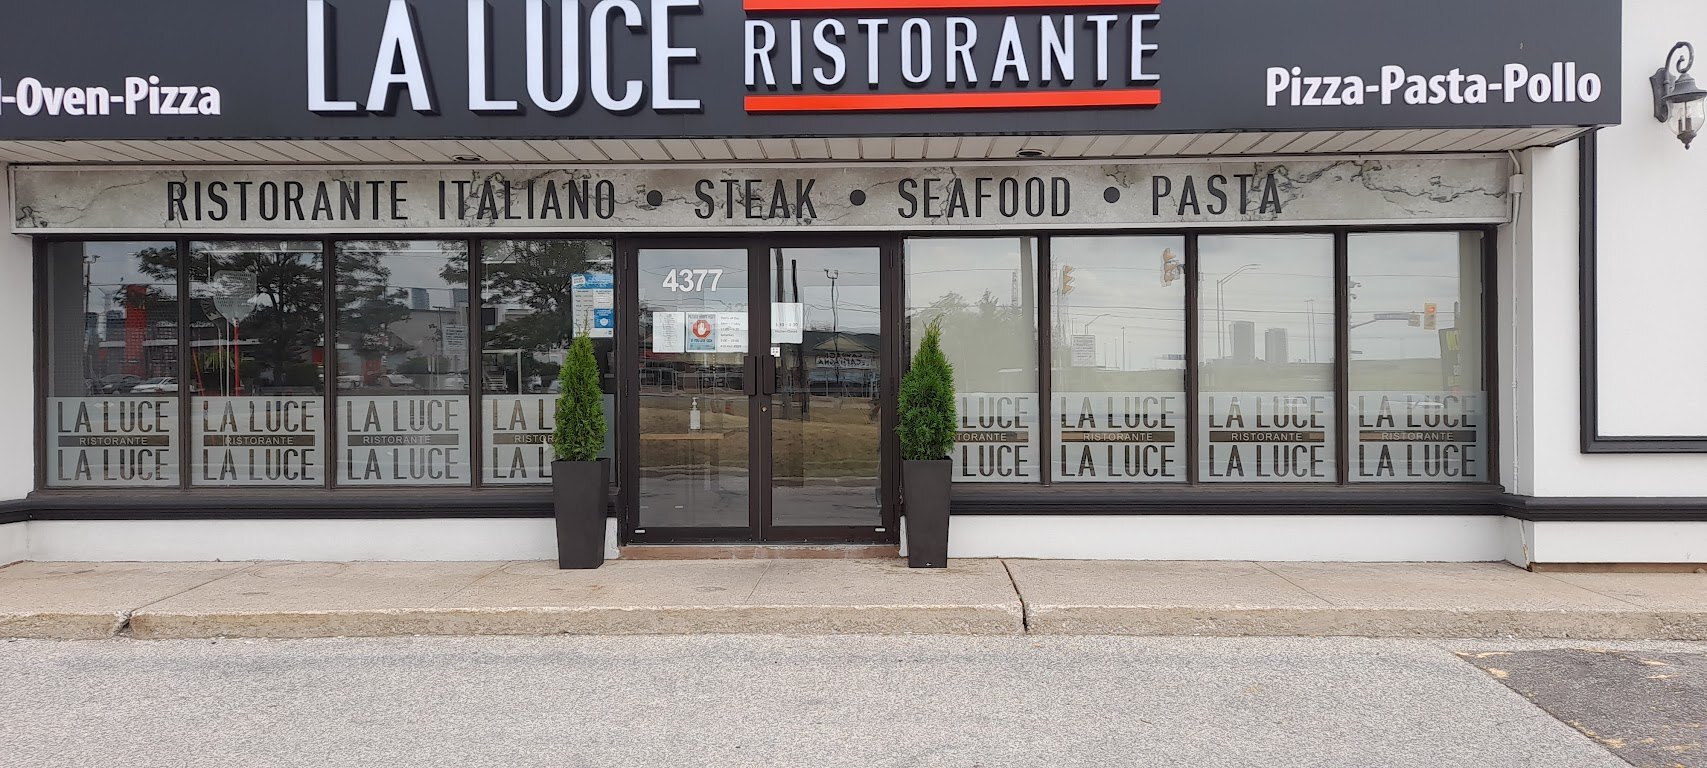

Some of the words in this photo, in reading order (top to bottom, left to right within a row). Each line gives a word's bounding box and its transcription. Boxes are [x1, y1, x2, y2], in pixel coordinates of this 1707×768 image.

[307, 0, 430, 112] LA
[467, 0, 701, 112] LUCE
[744, 14, 1161, 86] RISTORANTE
[0, 75, 221, 116] -Oven-Pizza
[1266, 62, 1602, 106] Pizza-Pasta-Pollo
[167, 180, 409, 221] RISTORANTE
[438, 179, 615, 220] ITALIANO
[694, 178, 818, 220] STEAK
[897, 176, 1071, 219] SEAFOOD
[1152, 173, 1282, 217] PASTA
[662, 268, 723, 292] 4377
[57, 401, 91, 433] LA
[103, 401, 169, 433] LUCE
[203, 400, 238, 433] LA
[249, 400, 316, 433] LUCE
[347, 400, 381, 432] LA
[393, 400, 459, 432] LUCE
[492, 399, 527, 431] LA
[962, 396, 1029, 429] LUCE
[1061, 396, 1096, 429] LA
[1108, 396, 1175, 429] LUCE
[1208, 395, 1244, 428] LA
[1256, 395, 1325, 428] LUCE
[1358, 395, 1395, 428] LA
[1407, 395, 1477, 428] LUCE
[79, 436, 148, 446] RISTORANTE
[225, 436, 293, 446] RISTORANTE
[363, 435, 431, 445] RISTORANTE
[514, 434, 553, 443] RISTOR
[953, 432, 1007, 442] TORANTE
[1083, 432, 1153, 441] RISTORANTE
[1231, 432, 1303, 441] RISTORANTE
[1381, 432, 1454, 441] RISTORANTE
[57, 449, 91, 481] LA
[103, 449, 169, 481] LUCE
[203, 448, 238, 481] LA
[249, 448, 316, 481] LUCE
[347, 448, 381, 480] LA
[393, 448, 459, 480] LUCE
[492, 447, 527, 478] LA
[962, 444, 1029, 477] LUCE
[1061, 444, 1096, 477] LA
[1108, 444, 1175, 477] LUCE
[1208, 444, 1244, 477] LA
[1256, 444, 1325, 477] LUCE
[1358, 444, 1395, 477] LA
[1407, 444, 1477, 477] LUCE
